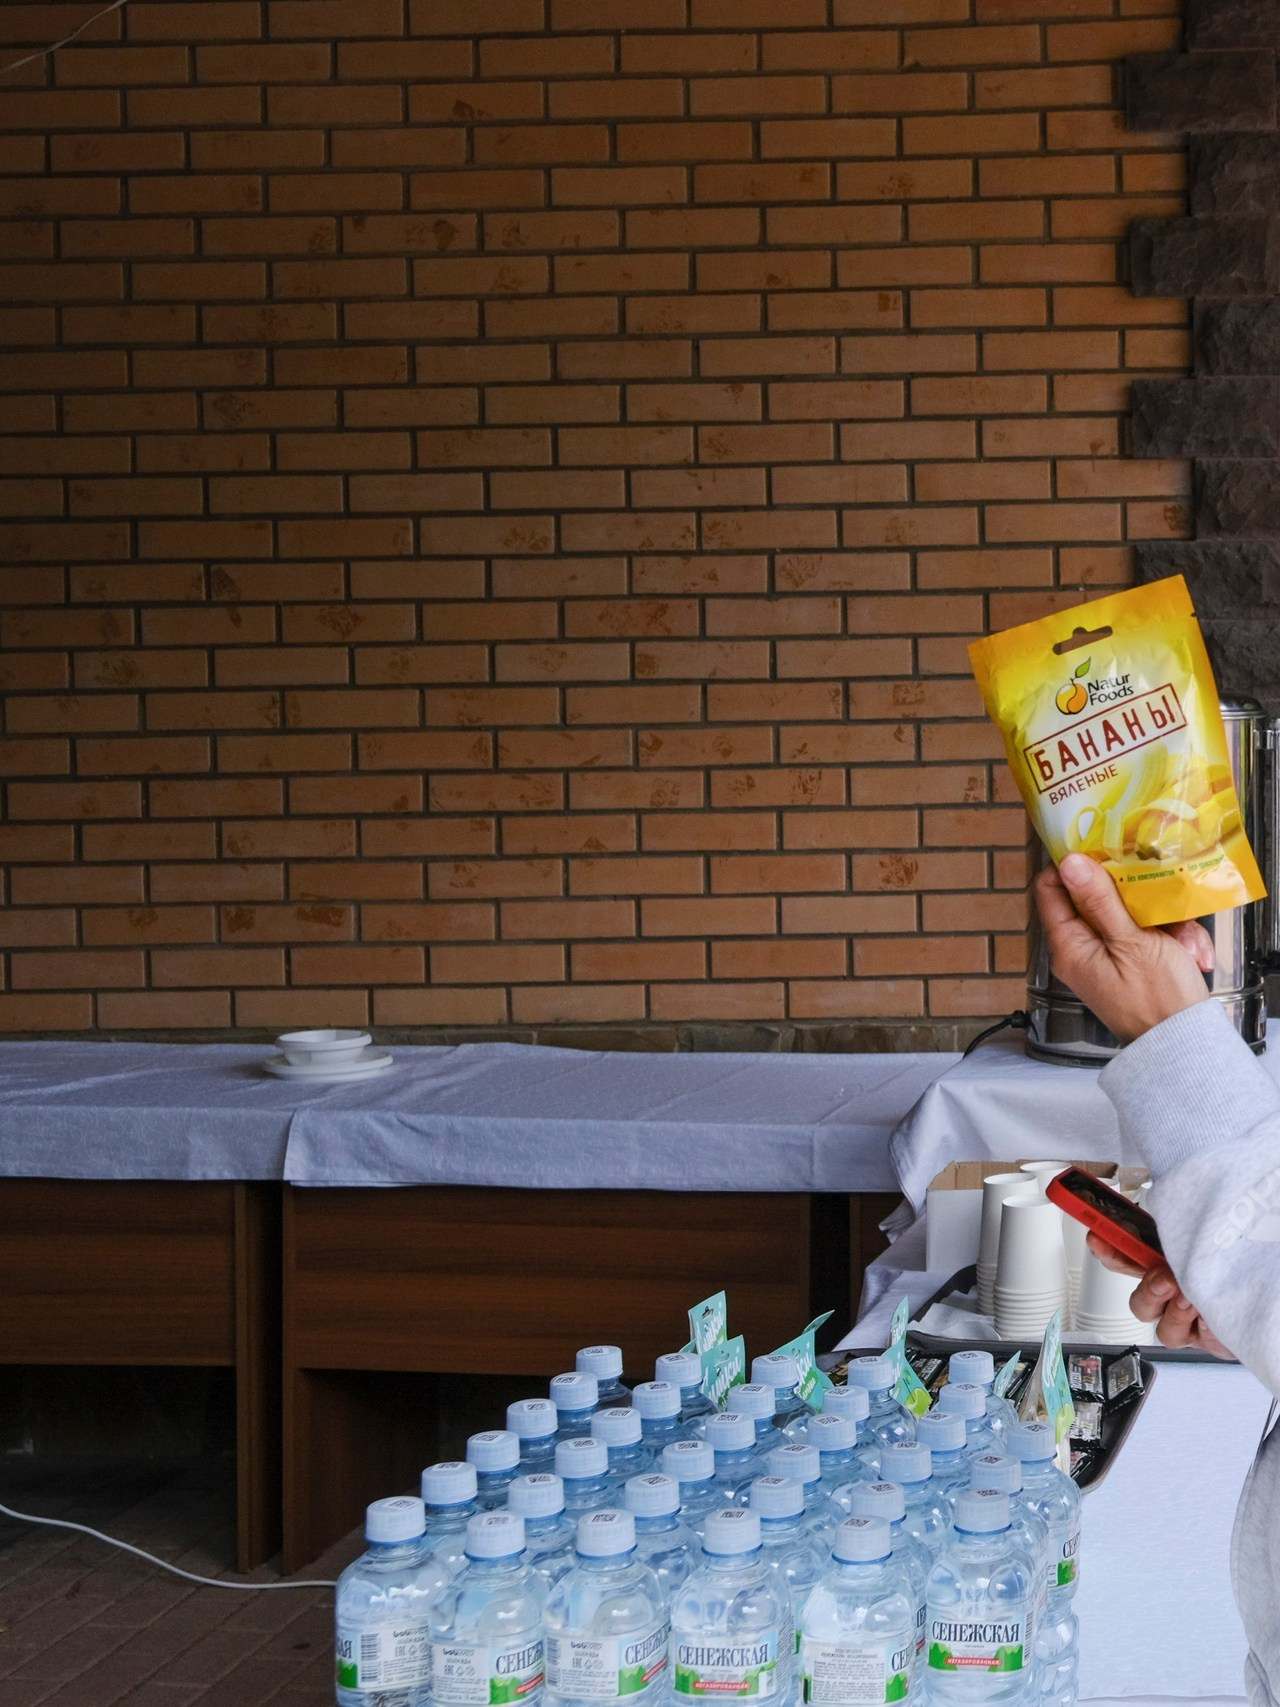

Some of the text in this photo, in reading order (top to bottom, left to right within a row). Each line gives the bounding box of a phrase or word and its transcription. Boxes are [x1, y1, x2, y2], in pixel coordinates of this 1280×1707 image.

[1087, 672, 1131, 694] Natur
[1089, 683, 1135, 706] Foods
[1033, 694, 1178, 782] БАНАНЫ
[1048, 763, 1119, 805] ВЯЛЕНЫЕ
[931, 1620, 1020, 1643] СЕНЕЖСКАЯ
[678, 1643, 769, 1667] СЕНЕЖСКАЯ
